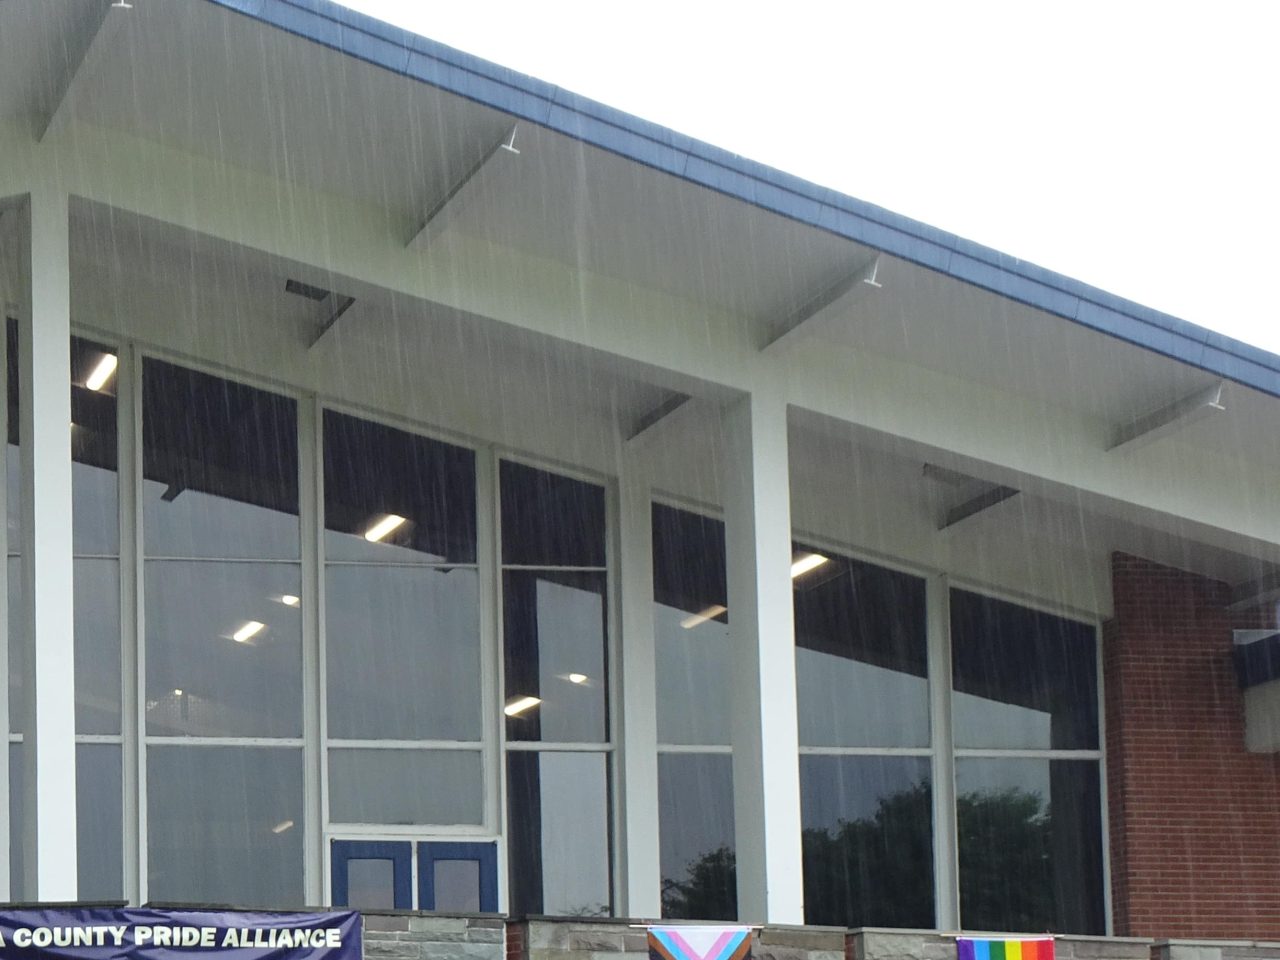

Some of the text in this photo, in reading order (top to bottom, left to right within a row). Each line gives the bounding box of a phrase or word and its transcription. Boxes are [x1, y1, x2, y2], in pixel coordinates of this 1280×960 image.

[13, 926, 128, 947] COUNTY
[134, 926, 216, 947] PRIDE
[222, 928, 342, 948] ALLIANCE
